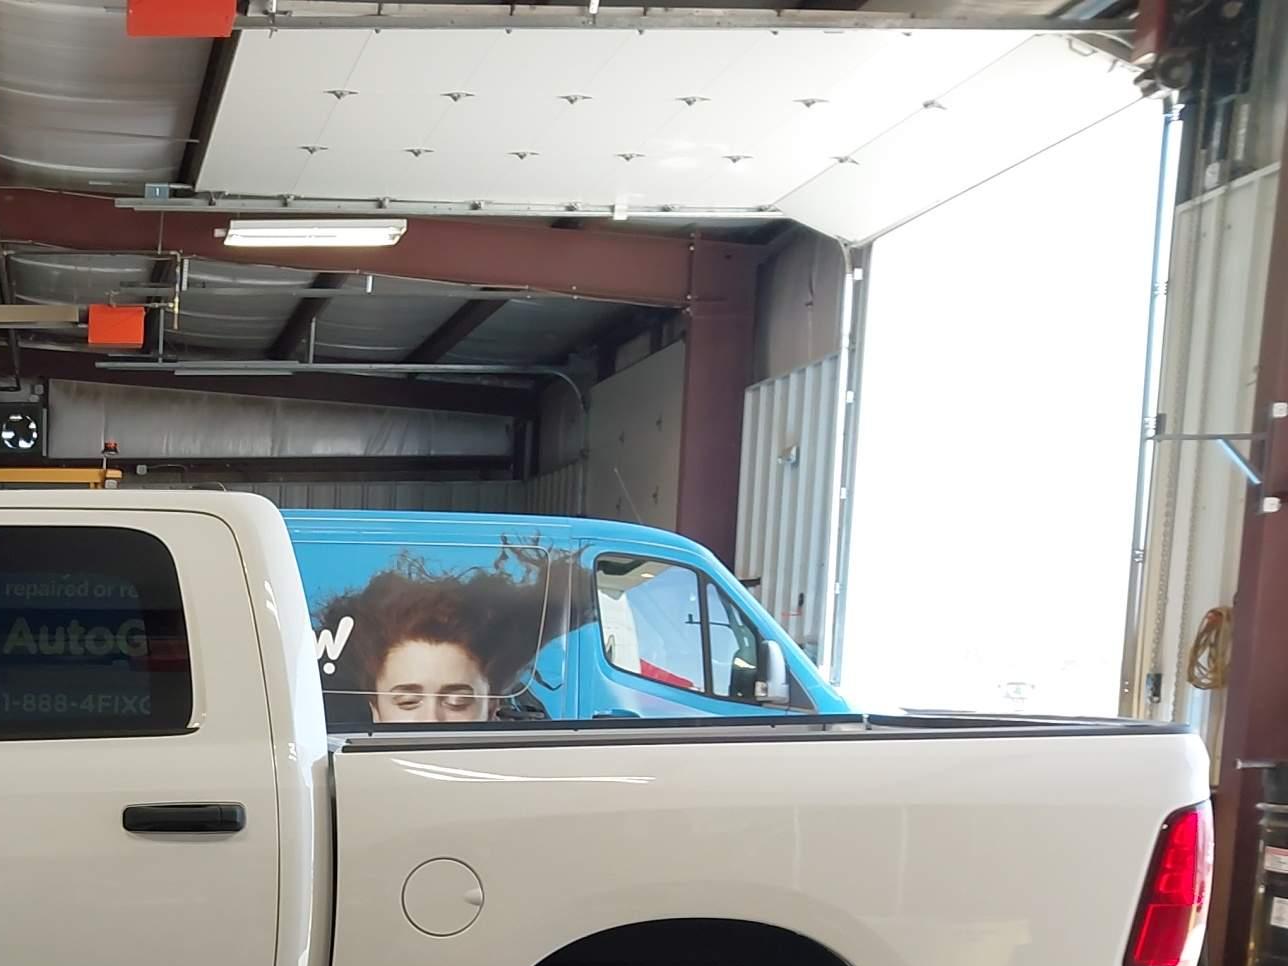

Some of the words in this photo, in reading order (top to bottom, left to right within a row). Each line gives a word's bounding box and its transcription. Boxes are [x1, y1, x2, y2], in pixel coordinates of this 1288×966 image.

[4, 579, 88, 599] repaired
[93, 583, 115, 598] or
[2, 615, 149, 656] AutoG
